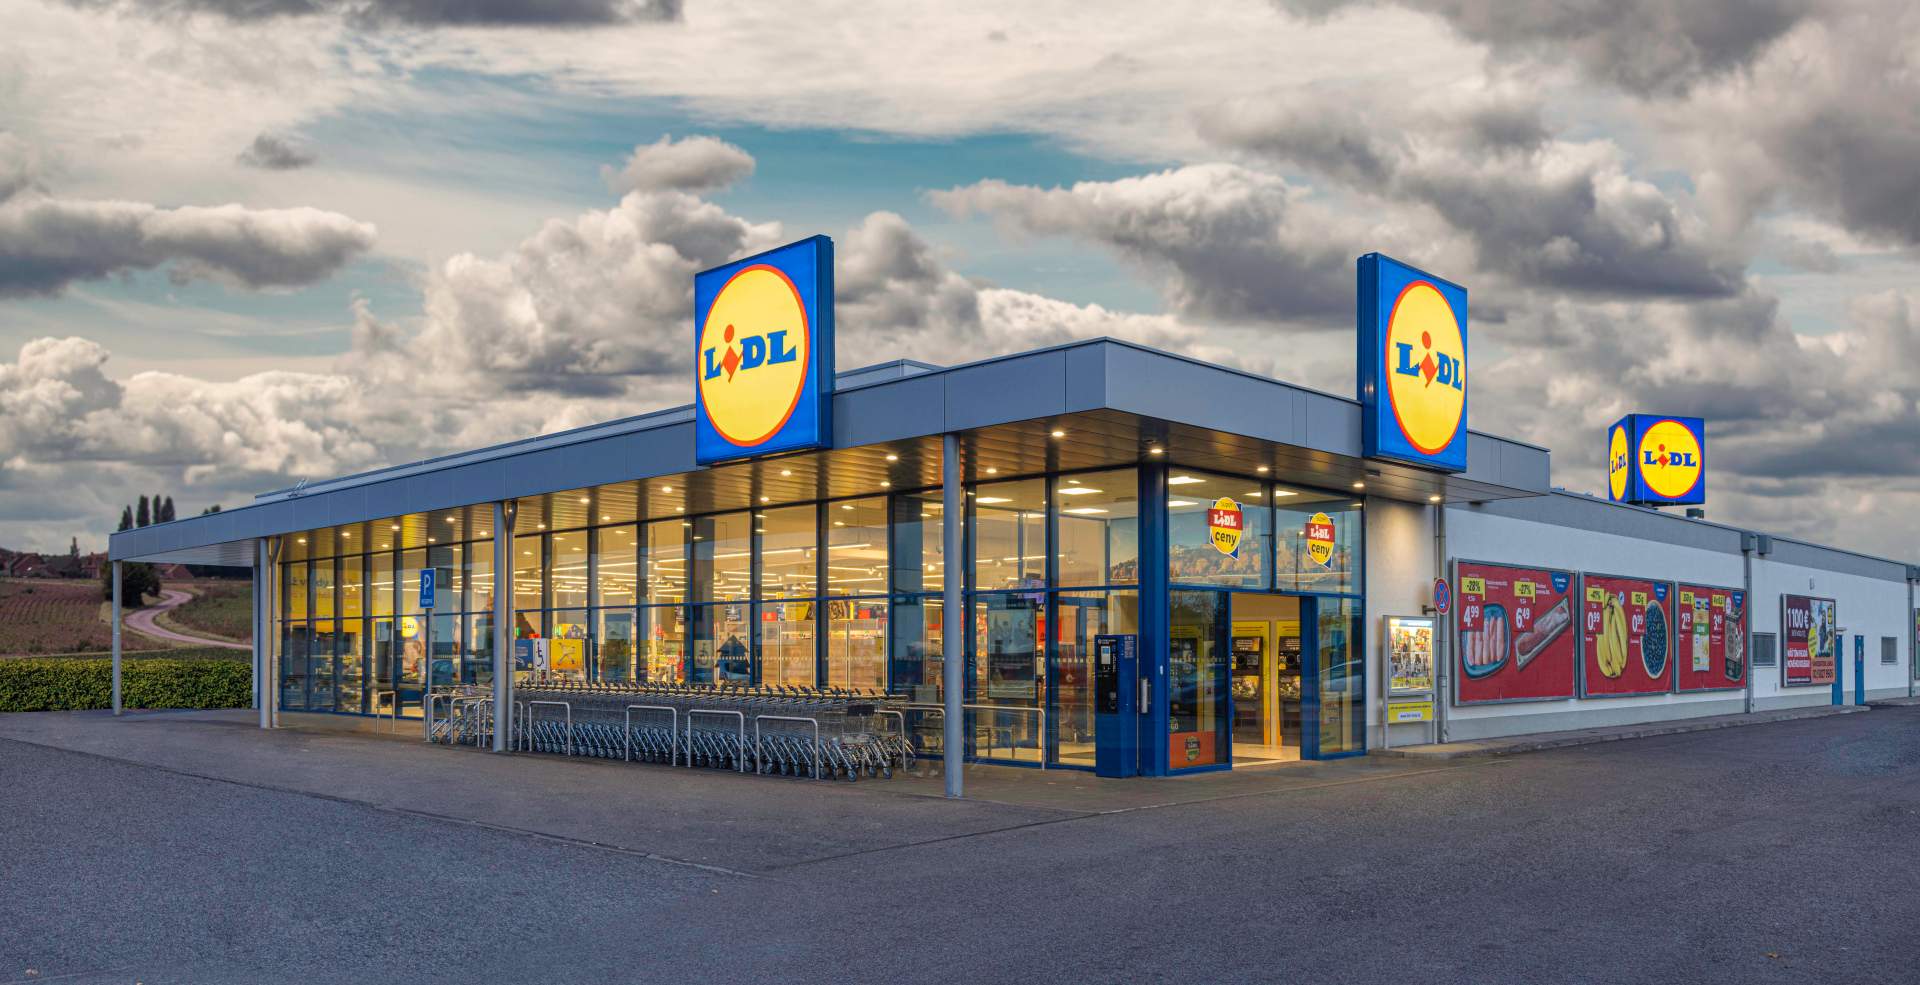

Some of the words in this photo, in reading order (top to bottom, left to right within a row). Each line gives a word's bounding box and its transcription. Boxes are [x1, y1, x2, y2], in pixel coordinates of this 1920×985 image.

[1215, 531, 1237, 548] ceny
[1311, 543, 1330, 558] ceny
[423, 574, 431, 596] P
